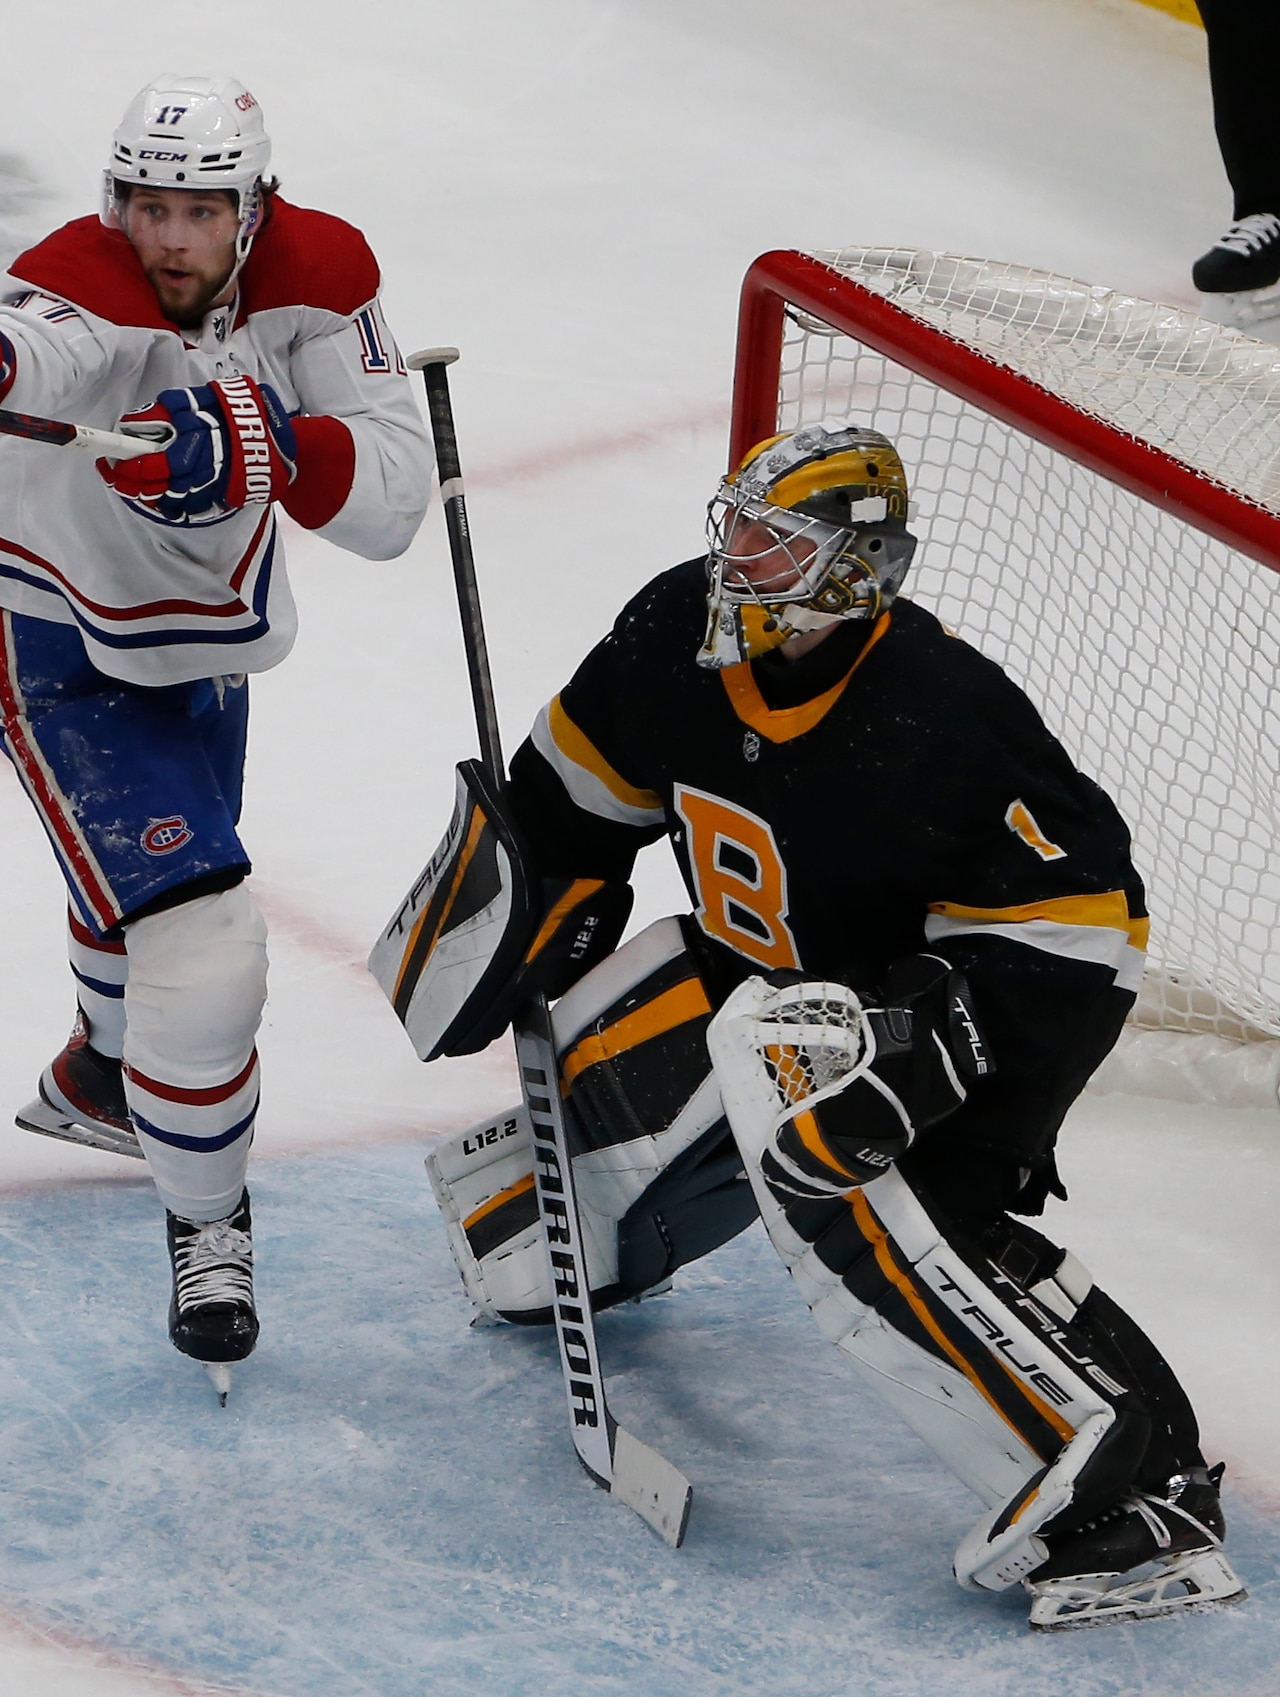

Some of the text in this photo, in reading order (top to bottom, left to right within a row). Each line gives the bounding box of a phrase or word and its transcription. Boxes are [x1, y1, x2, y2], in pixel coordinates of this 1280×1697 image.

[156, 106, 188, 125] 17
[138, 150, 189, 163] CCM
[1004, 798, 1068, 862] 1
[673, 781, 804, 972] B
[569, 915, 600, 961] L12.2
[954, 997, 988, 1075] TRUE
[463, 1118, 518, 1157] L12.2
[522, 1066, 600, 1429] WARRIOR
[934, 1264, 1075, 1406] TRUE
[986, 1258, 1129, 1397] TRUE
